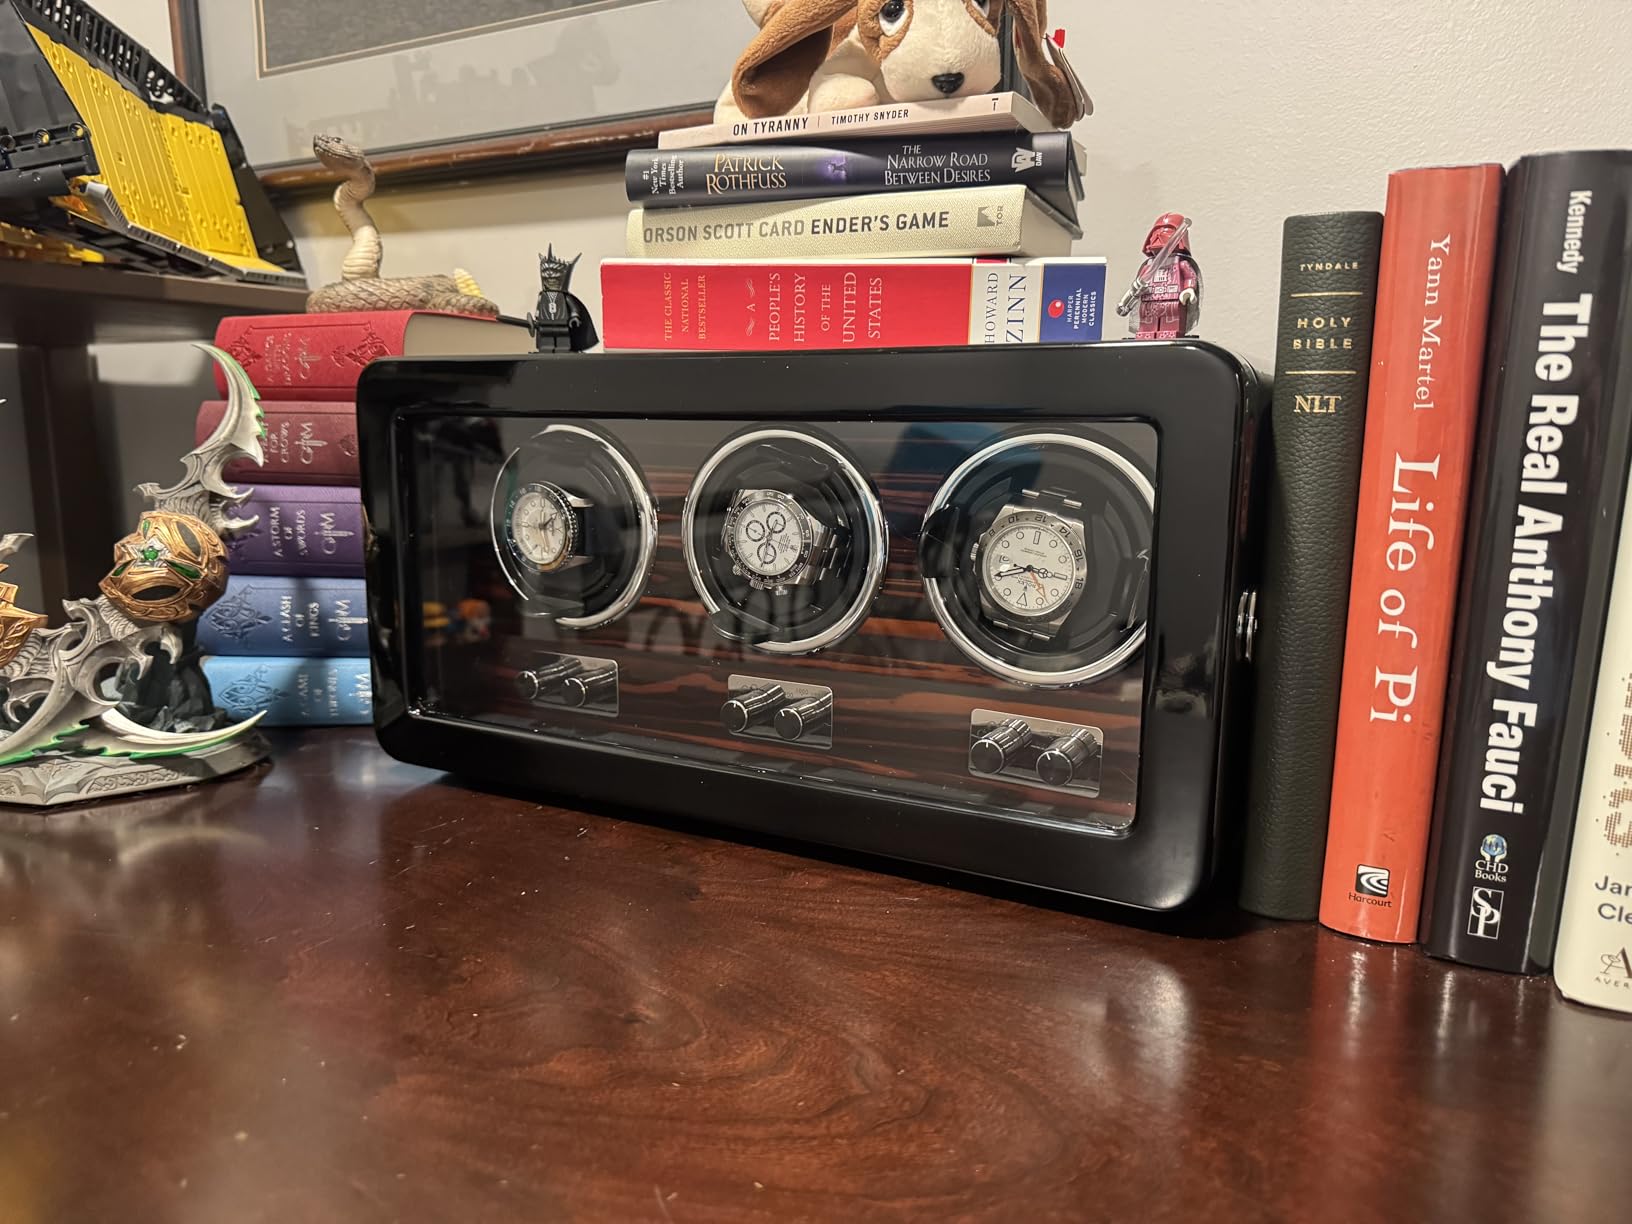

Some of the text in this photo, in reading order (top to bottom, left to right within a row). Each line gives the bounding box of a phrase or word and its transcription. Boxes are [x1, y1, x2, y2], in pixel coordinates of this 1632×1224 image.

[732, 108, 909, 137] ON TYRANNY TIMOTHY SNYDER
[714, 153, 784, 173] PATRICK
[886, 151, 988, 170] NARROW ROAD
[902, 144, 922, 155] THE
[651, 174, 660, 195] New
[659, 162, 667, 187] Times
[675, 159, 685, 189] Author
[705, 172, 787, 195] ROTHFUSS
[884, 167, 991, 186] BETWEEN DESIRES
[642, 211, 950, 243] ORSON SCOTT CARD ENDER'S GAME
[995, 205, 1004, 225] TOR
[1556, 190, 1593, 274] Kennedy
[1299, 261, 1360, 272] TYNDALE
[664, 272, 672, 341] THE CLASSIC
[681, 278, 689, 333] NATIONAL
[698, 274, 707, 340] BESTSELLER
[746, 303, 756, 312] A
[768, 272, 781, 341] PEOPLE'S
[793, 272, 807, 343] HISTORY
[820, 283, 831, 332] OF THE
[842, 271, 857, 344] UNITED
[867, 276, 883, 339] STATES
[984, 272, 999, 344] HOWARD
[1005, 273, 1027, 343] ZINN
[1073, 288, 1082, 330] PERENNIAL
[1081, 294, 1089, 324] MODERN
[1088, 290, 1097, 327] CLASSICS
[1296, 316, 1353, 329] HOLY
[1413, 233, 1451, 411] Yann Martel
[1292, 337, 1353, 350] BIBLE
[1293, 394, 1343, 414] NLT
[269, 505, 282, 548] STORM
[295, 508, 309, 556] SWORDS
[1479, 293, 1593, 815] The Real Anthony Fauci
[1369, 451, 1442, 723] Life of Pi
[1474, 859, 1510, 874] CHD
[1474, 869, 1508, 883] Books
[1347, 892, 1393, 908] Harcourt
